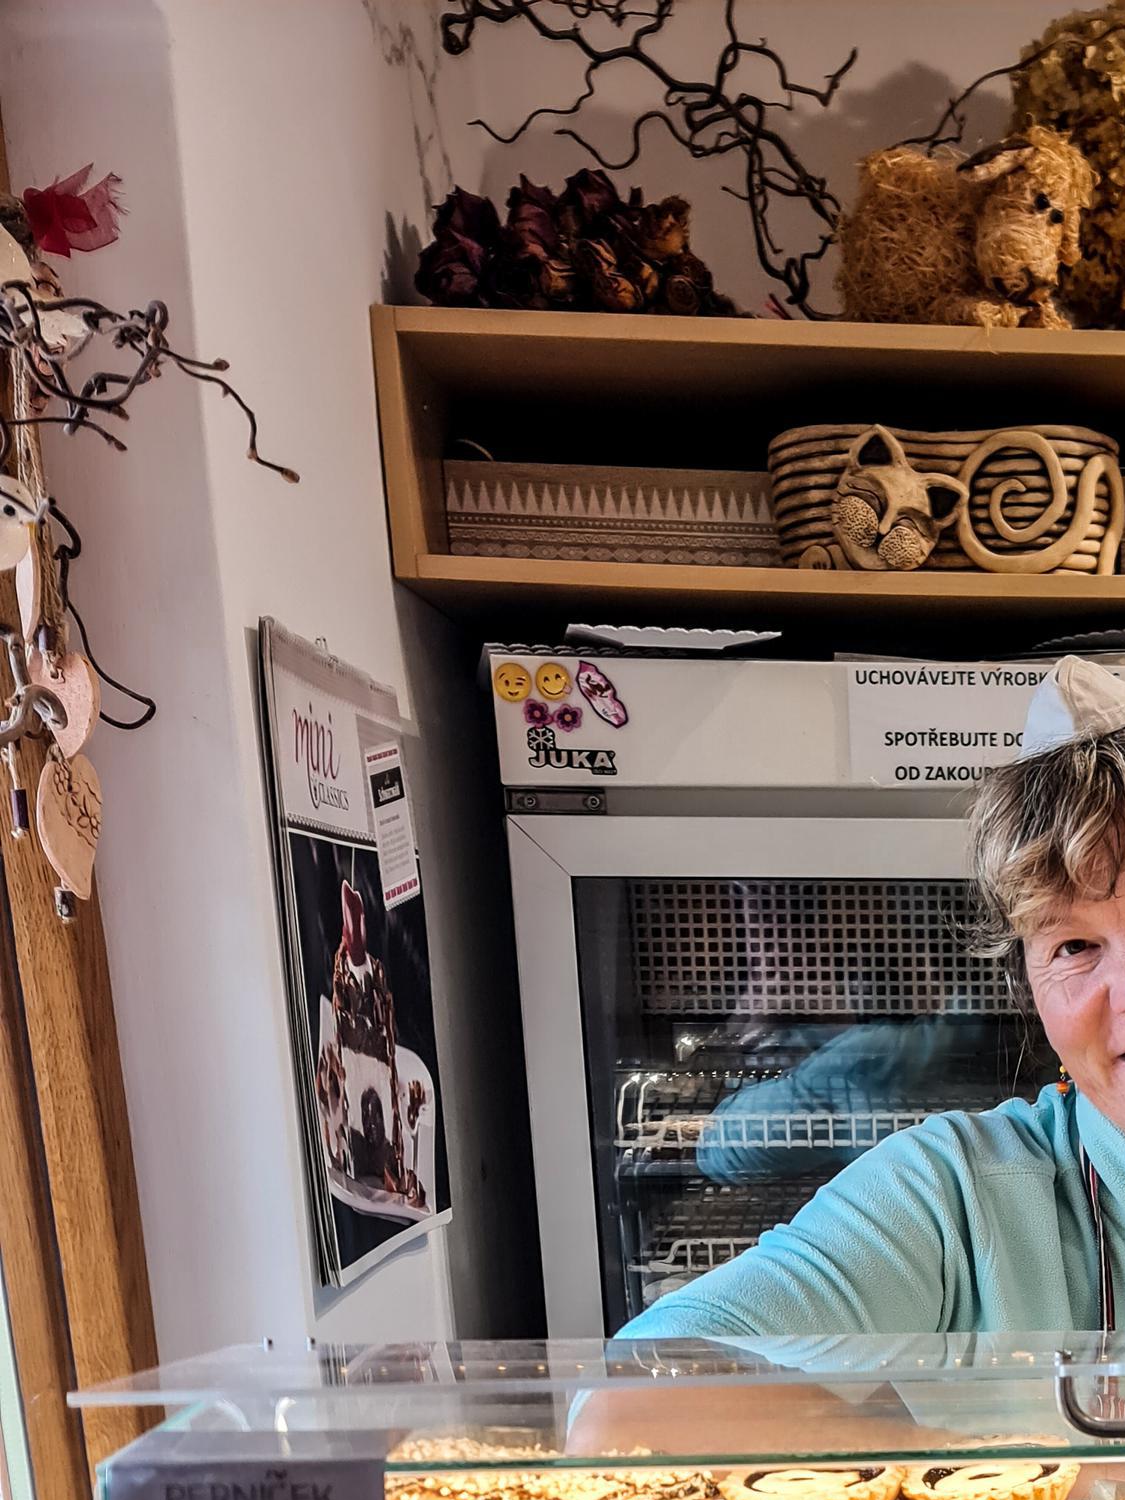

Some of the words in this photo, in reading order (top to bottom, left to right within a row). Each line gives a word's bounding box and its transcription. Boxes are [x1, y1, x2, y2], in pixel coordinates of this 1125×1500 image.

[855, 667, 976, 686] UCHOVÁVEJTE
[884, 728, 998, 747] SPOTŘEBUJTE
[292, 700, 342, 809] mini
[529, 750, 613, 769] JUKA
[895, 765, 920, 781] OD
